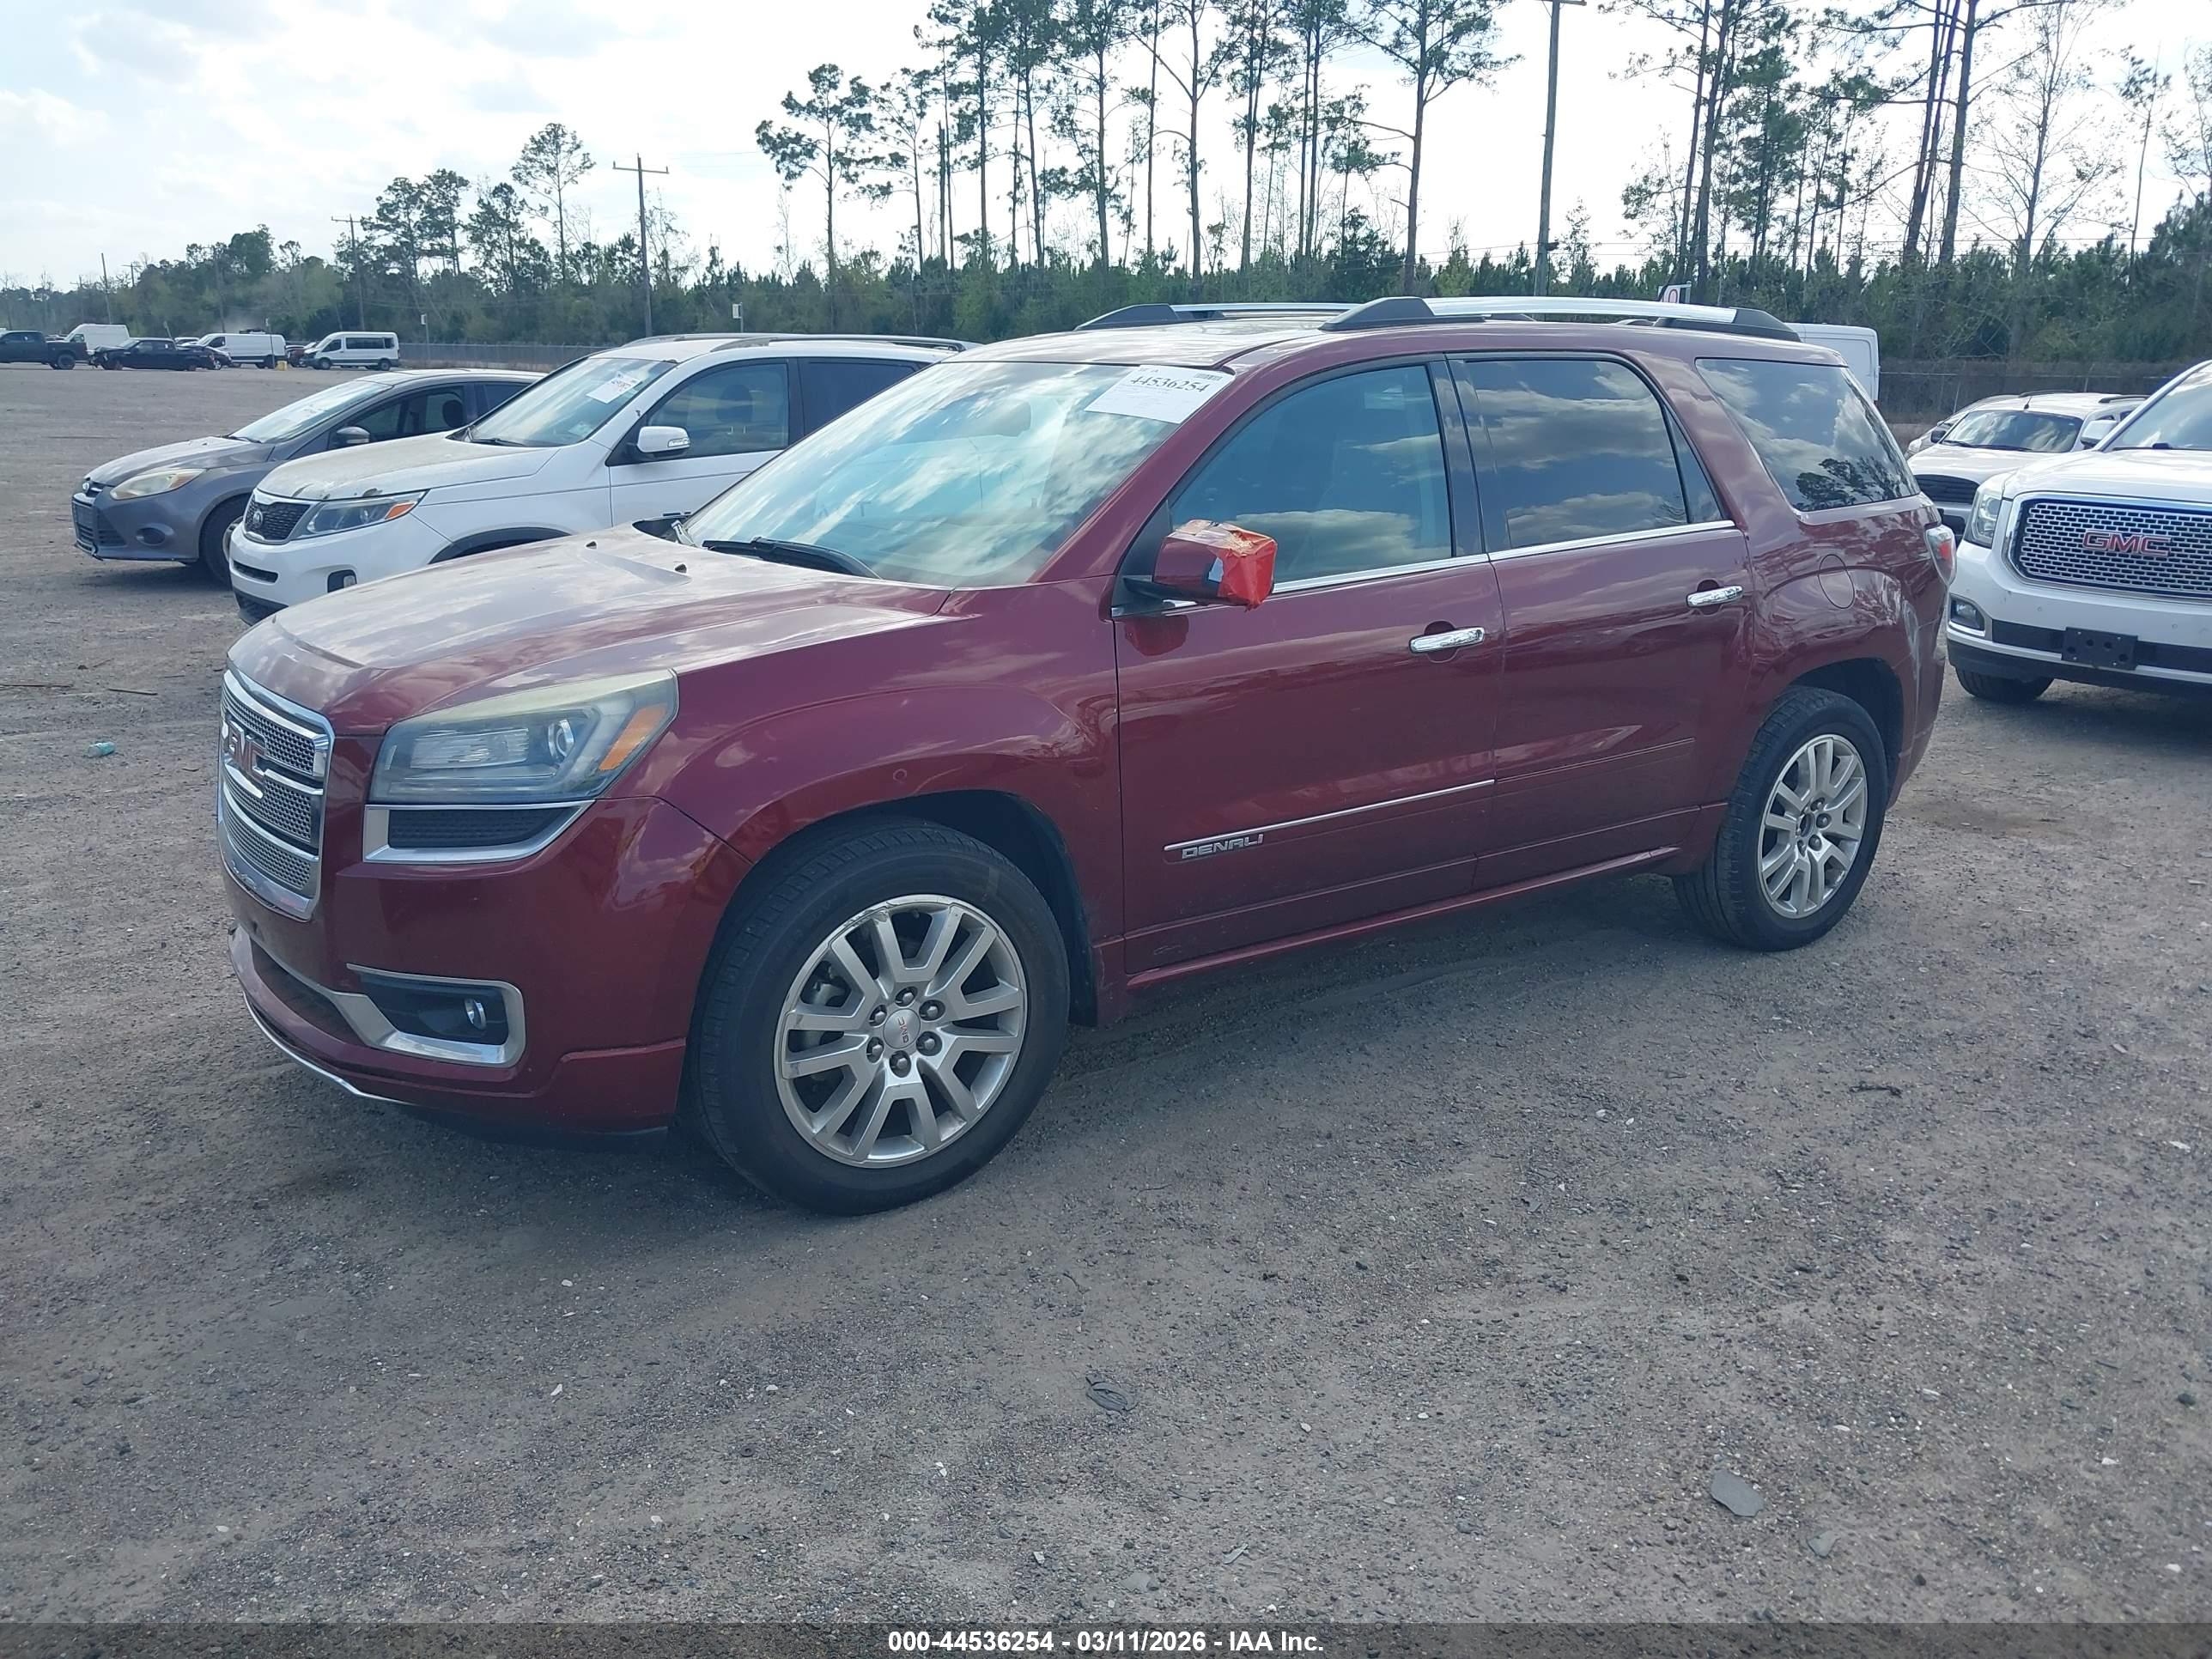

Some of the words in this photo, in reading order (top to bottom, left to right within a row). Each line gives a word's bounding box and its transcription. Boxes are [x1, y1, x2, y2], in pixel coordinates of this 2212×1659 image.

[1130, 375, 1211, 392] 44536254
[2082, 529, 2172, 558] GMC
[1182, 833, 1264, 860] DENALI
[897, 1016, 909, 1043] GMC
